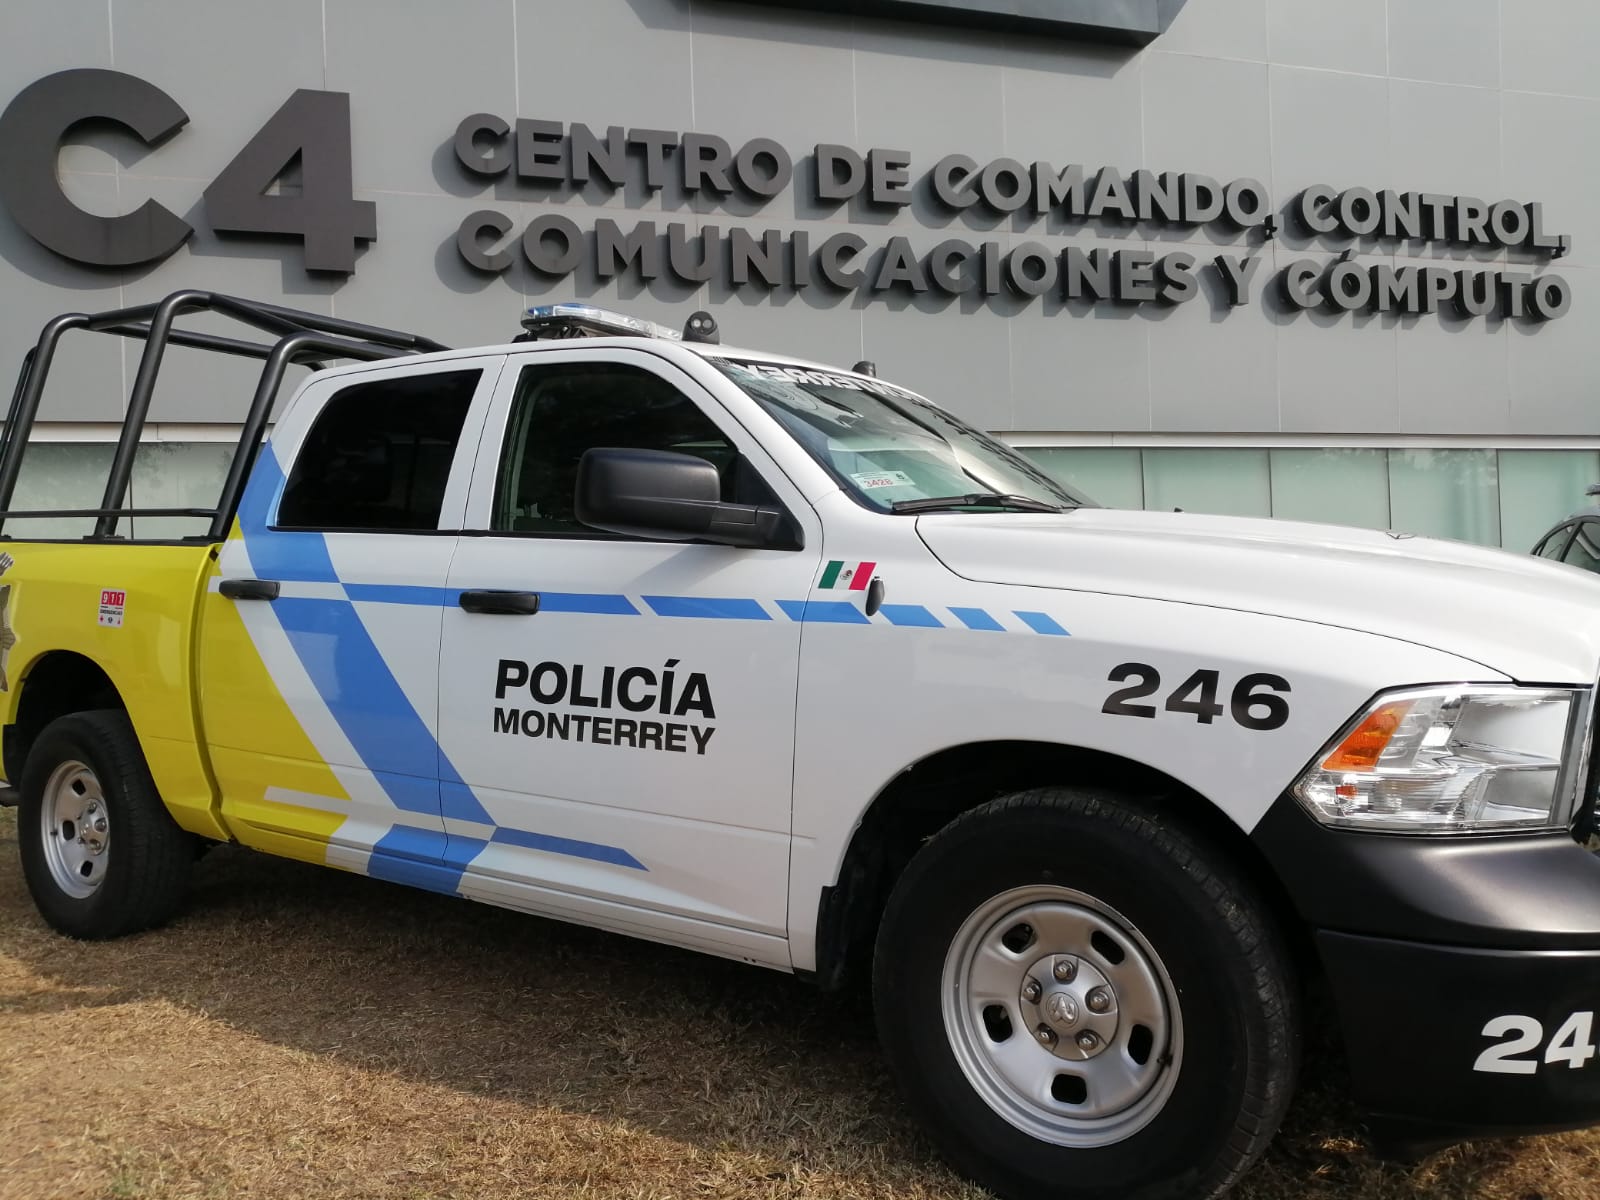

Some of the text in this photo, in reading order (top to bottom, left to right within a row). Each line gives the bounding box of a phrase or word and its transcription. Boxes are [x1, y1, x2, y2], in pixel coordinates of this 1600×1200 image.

[0, 68, 377, 275] C4
[455, 113, 1572, 259] CENTRO DE COMANDO, CONTROL,
[457, 210, 1572, 321] COMUNICACIONES Y CÓMPUTO
[102, 592, 123, 605] 911
[495, 659, 716, 719] POLICÍA
[1101, 662, 1292, 730] 246
[493, 707, 716, 755] MONTERREY
[1473, 1011, 1600, 1074] 24
